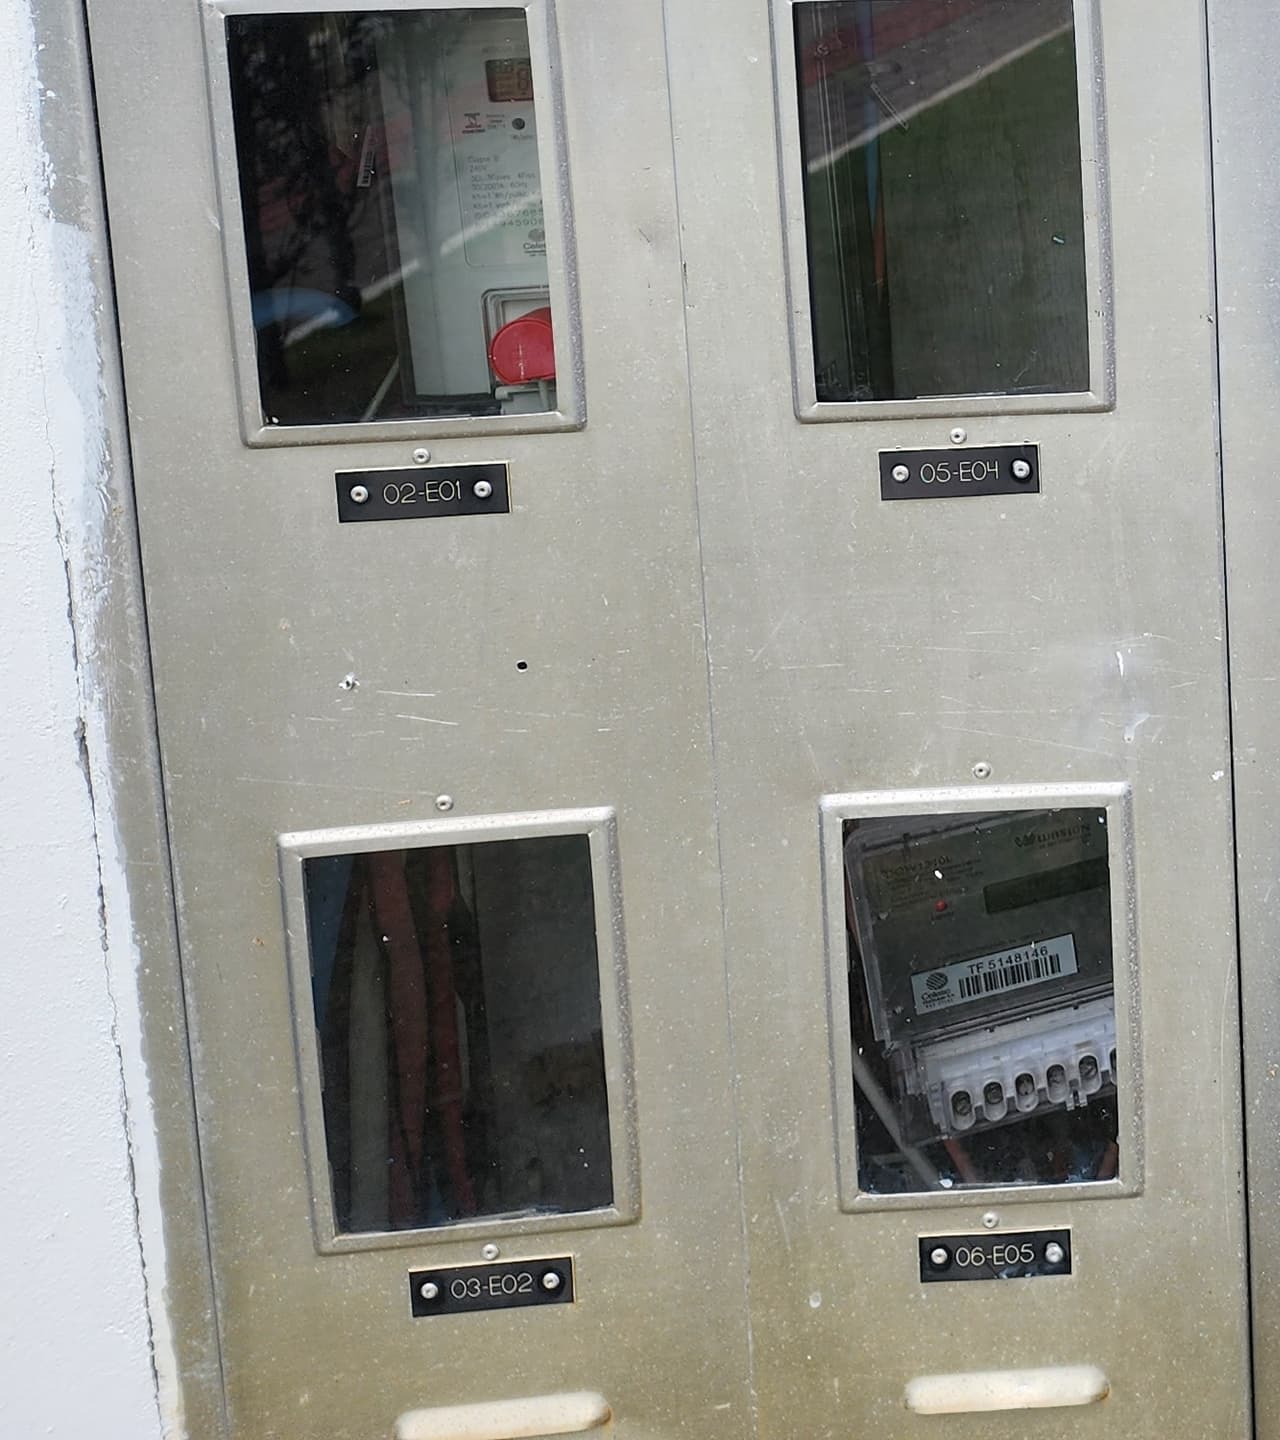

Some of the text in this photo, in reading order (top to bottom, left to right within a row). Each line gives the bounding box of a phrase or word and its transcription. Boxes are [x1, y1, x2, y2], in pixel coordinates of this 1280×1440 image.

[920, 462, 999, 483] 05-E04
[383, 481, 462, 505] 02-E01
[968, 946, 1049, 975] TF 5148146
[956, 1244, 1035, 1267] 06-E05
[450, 1273, 534, 1300] 03-E02
